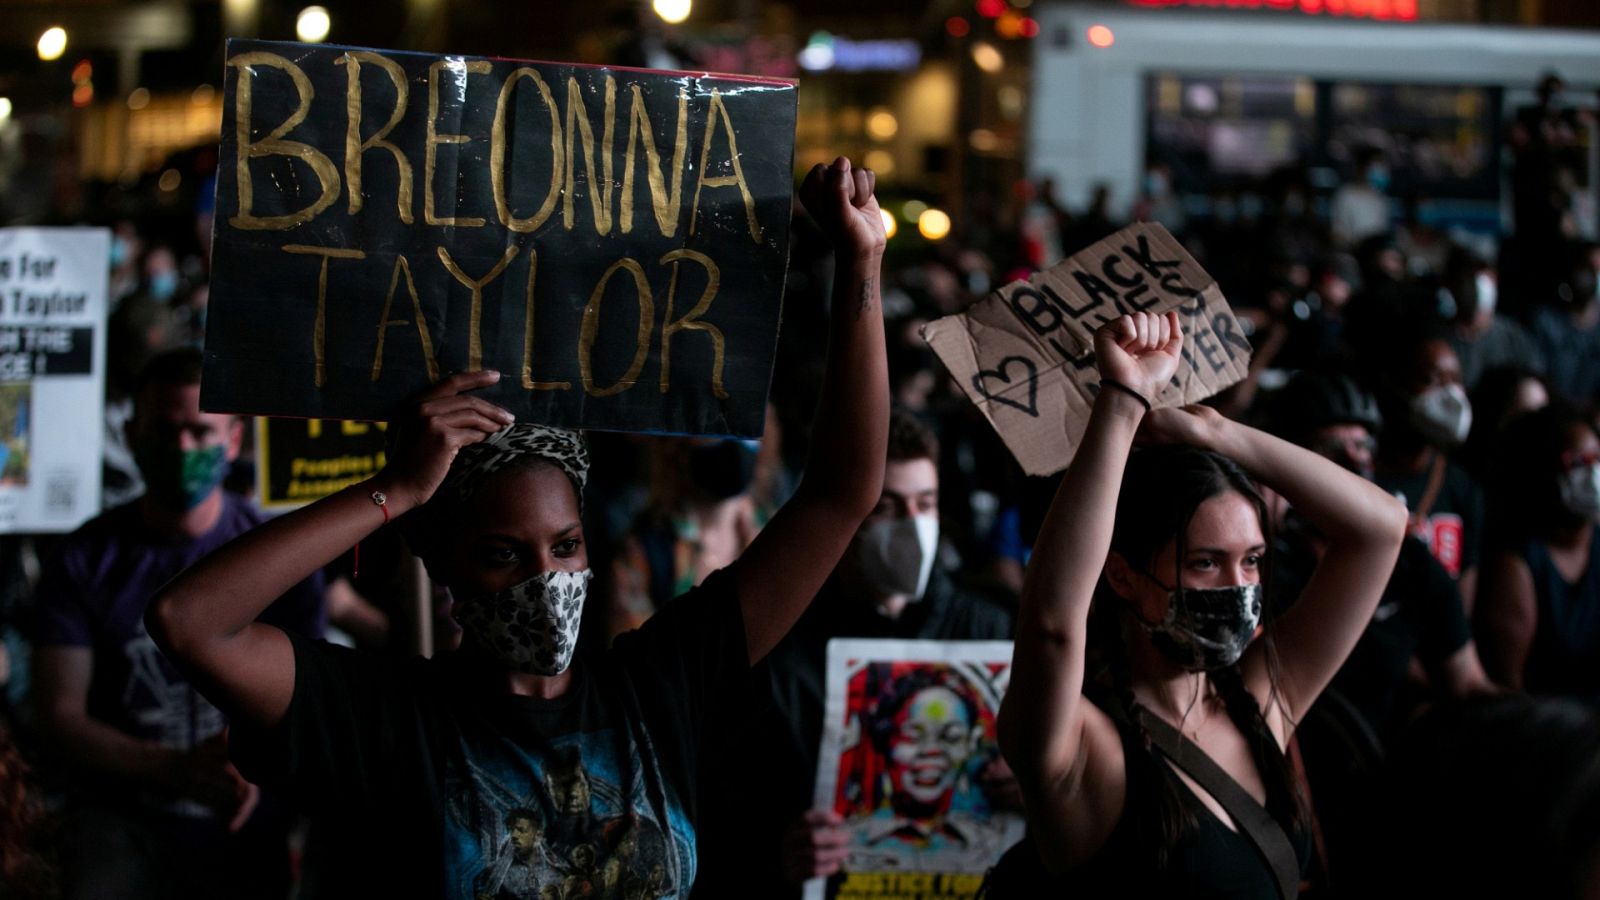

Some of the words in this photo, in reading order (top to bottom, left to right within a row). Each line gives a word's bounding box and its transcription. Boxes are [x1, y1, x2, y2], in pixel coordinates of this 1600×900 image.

[227, 51, 762, 243] BREONNA
[20, 254, 57, 279] For
[1010, 235, 1180, 335] BLACK
[13, 290, 85, 316] Taylor
[282, 246, 729, 399] TAYLOR
[839, 873, 933, 893] JUSTICE
